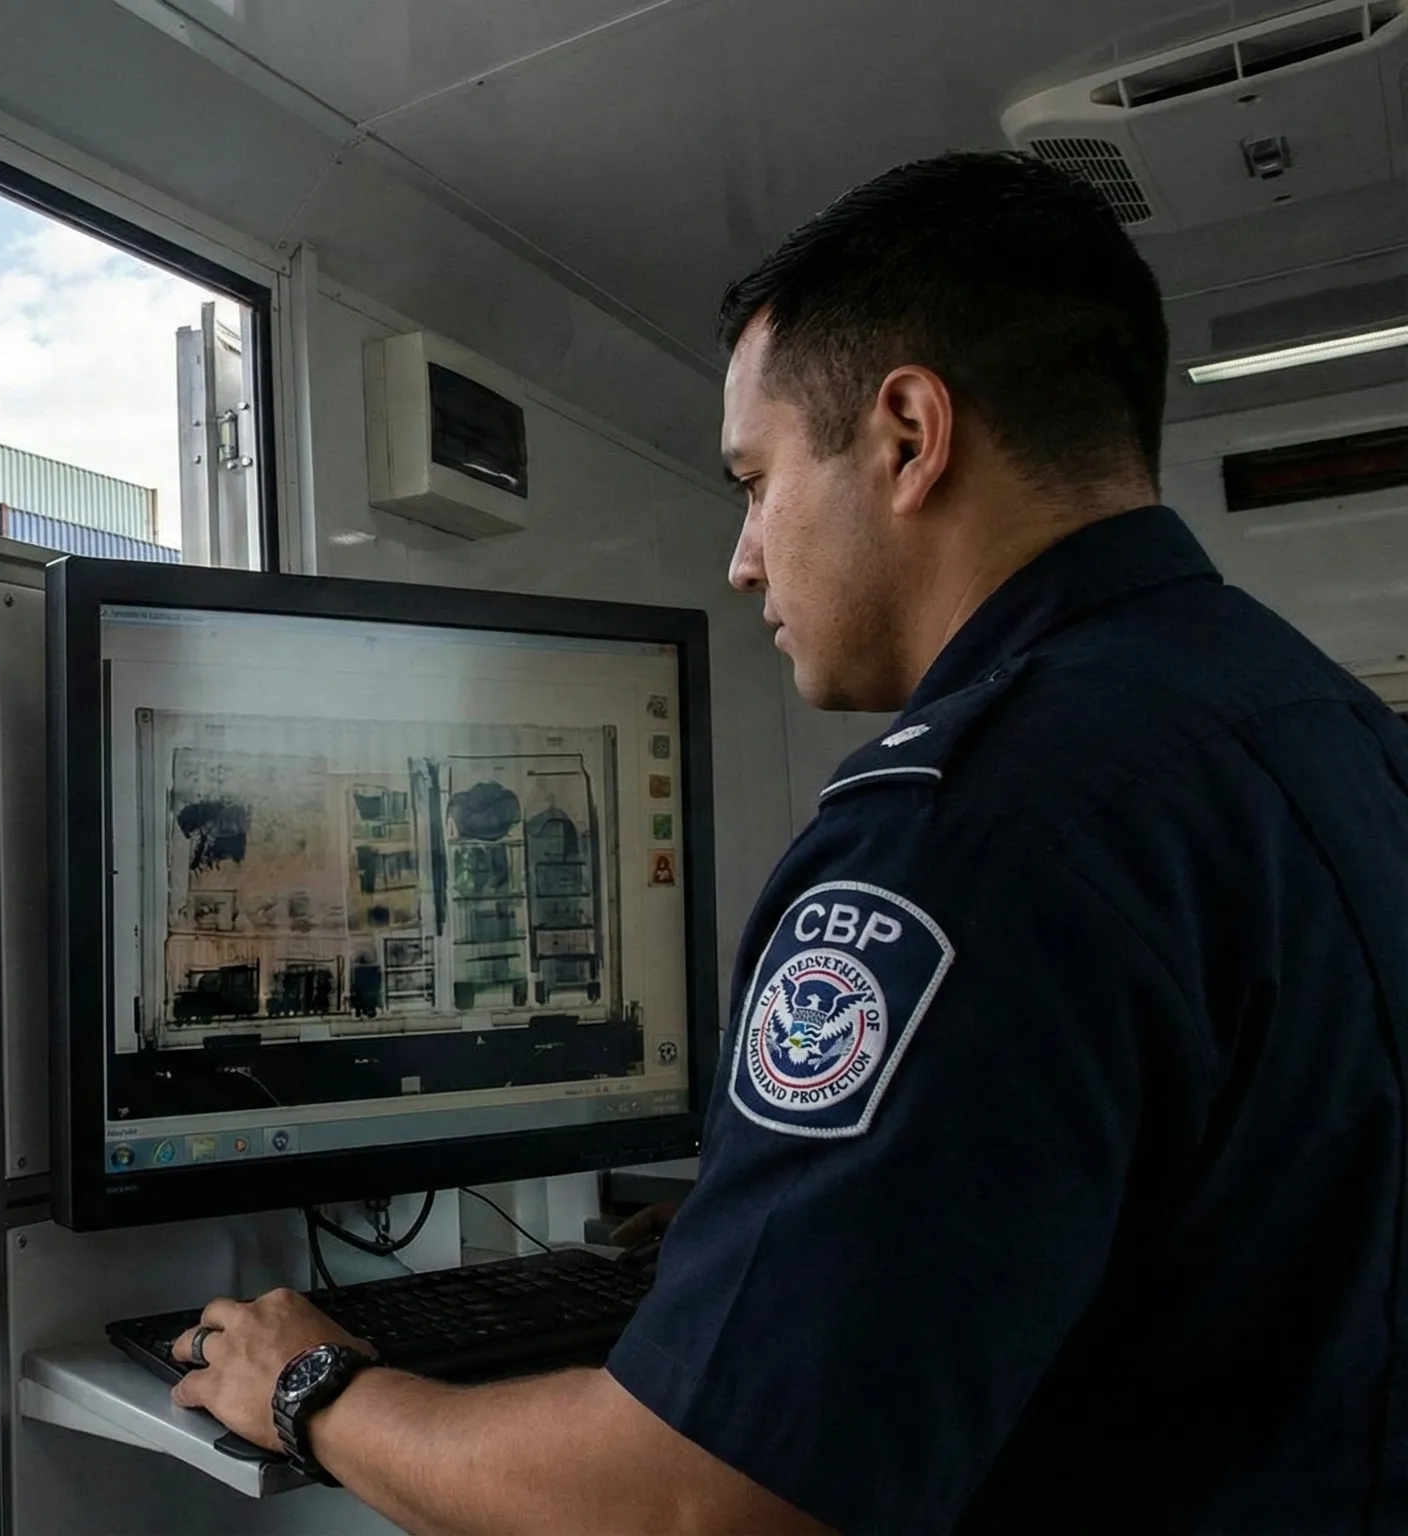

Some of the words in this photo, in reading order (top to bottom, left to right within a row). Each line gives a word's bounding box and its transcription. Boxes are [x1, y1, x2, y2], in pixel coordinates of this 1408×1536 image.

[794, 902, 902, 951] CBP
[866, 1009, 880, 1032] OF
[790, 1050, 872, 1104] PROTECTION
